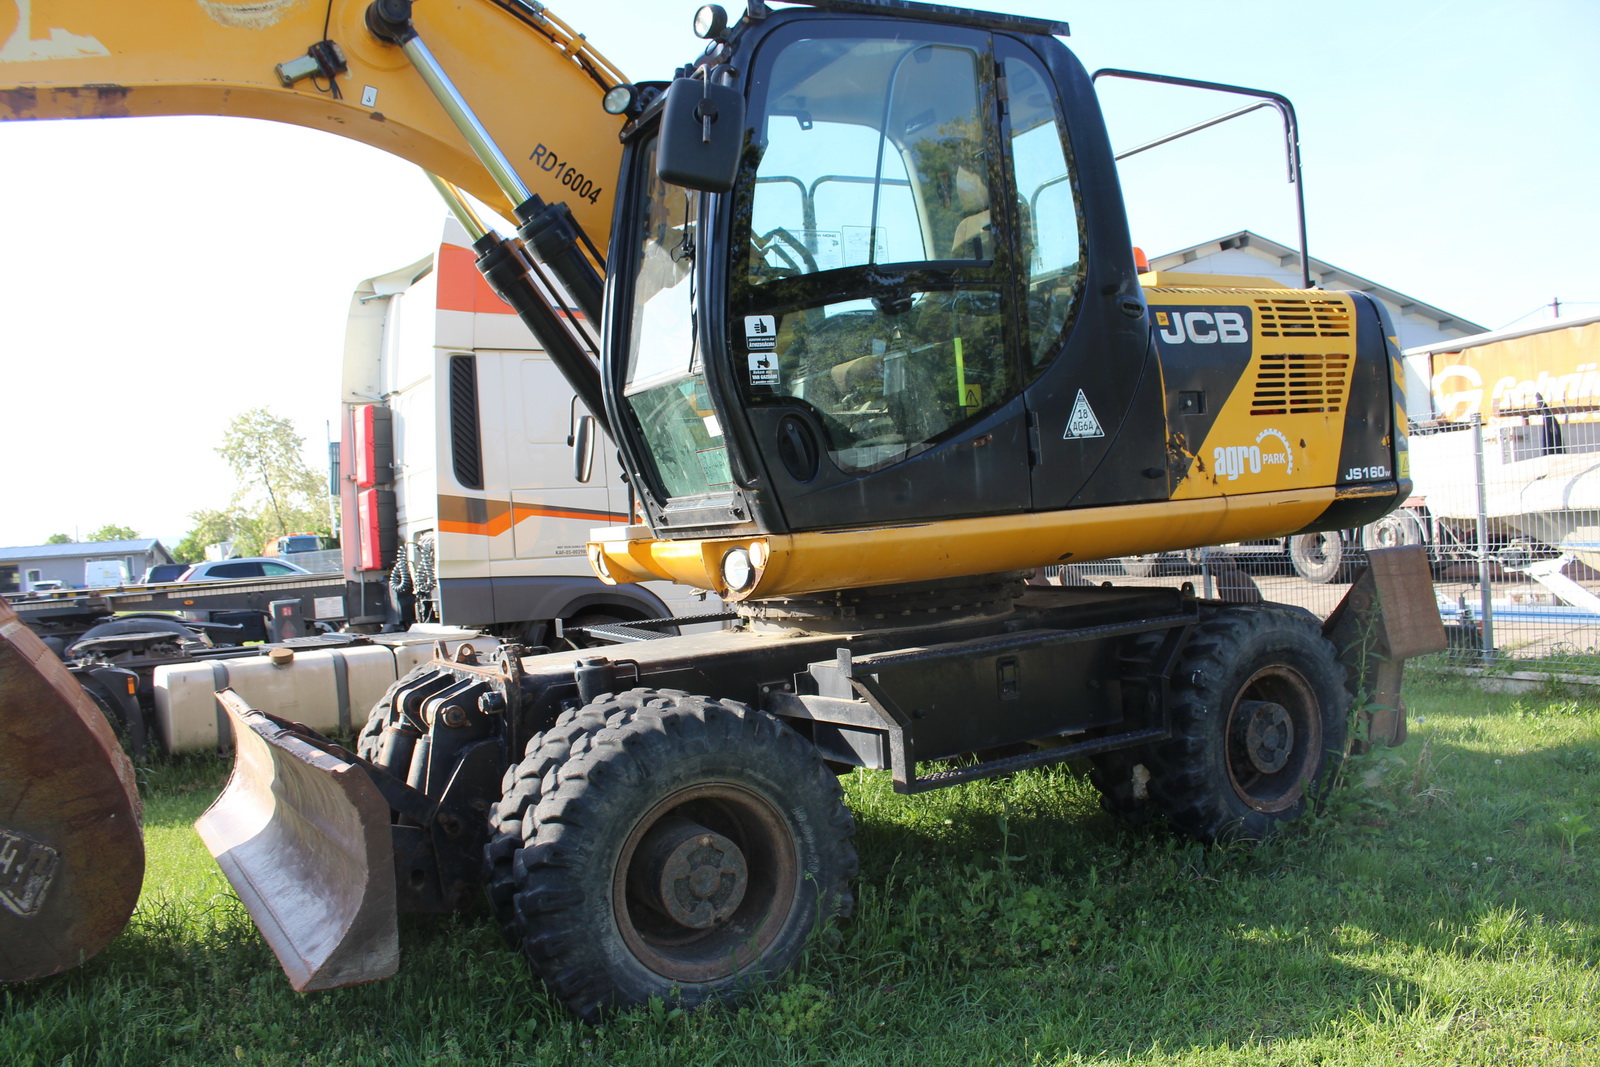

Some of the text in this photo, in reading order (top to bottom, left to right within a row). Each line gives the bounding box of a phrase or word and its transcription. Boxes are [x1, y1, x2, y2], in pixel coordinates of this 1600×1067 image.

[529, 143, 602, 205] RD16004
[1160, 312, 1249, 344] JCB
[1077, 408, 1089, 420] 18
[1213, 445, 1286, 481] agro PARK
